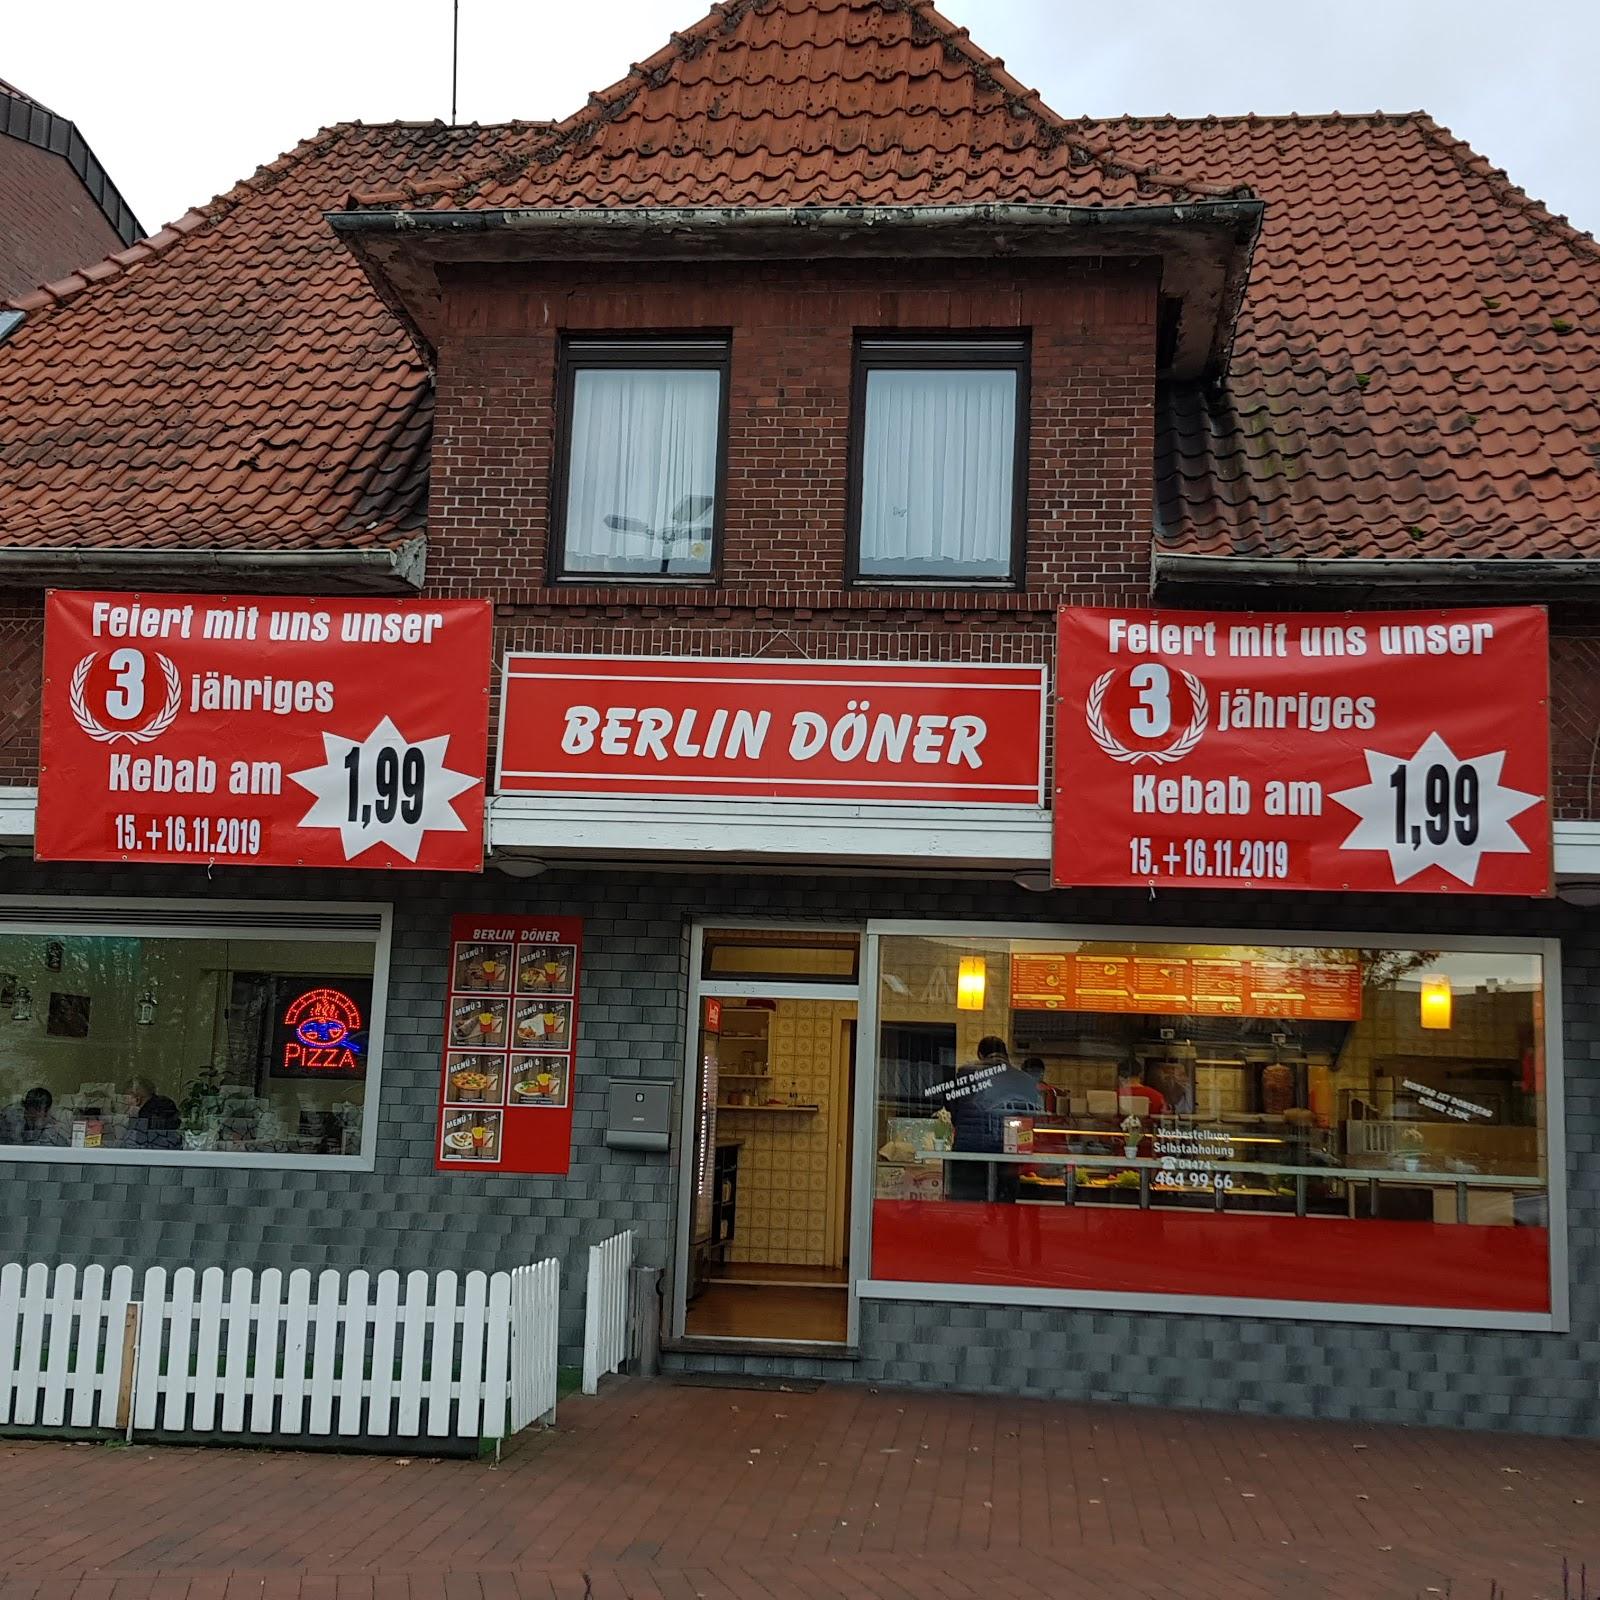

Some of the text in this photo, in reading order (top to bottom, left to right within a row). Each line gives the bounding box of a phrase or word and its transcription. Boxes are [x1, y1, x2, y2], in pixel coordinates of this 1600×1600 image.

[92, 601, 443, 644] Feiert mit uns unser
[1108, 618, 1494, 659] Feiert mit uns unser
[105, 647, 334, 721] 3 jähriges
[1128, 663, 1376, 739] 3 jähriges
[560, 700, 988, 770] BERLIN DÖNER
[109, 752, 282, 796] Kebab am
[343, 746, 424, 829] 1,99
[1132, 774, 1322, 818] Kebab am
[1389, 763, 1479, 852] 1,99
[472, 927, 560, 943] BERLIN DÖNER
[284, 1042, 355, 1068] PIZZA
[924, 1063, 1007, 1097] MONTAG IST DÖNERTAG
[945, 1085, 971, 1101] DÖNER
[1154, 1142, 1235, 1158] Selbstabholung
[1157, 1128, 1230, 1143] Vorbestellung
[1155, 1171, 1234, 1189] 464 99 66
